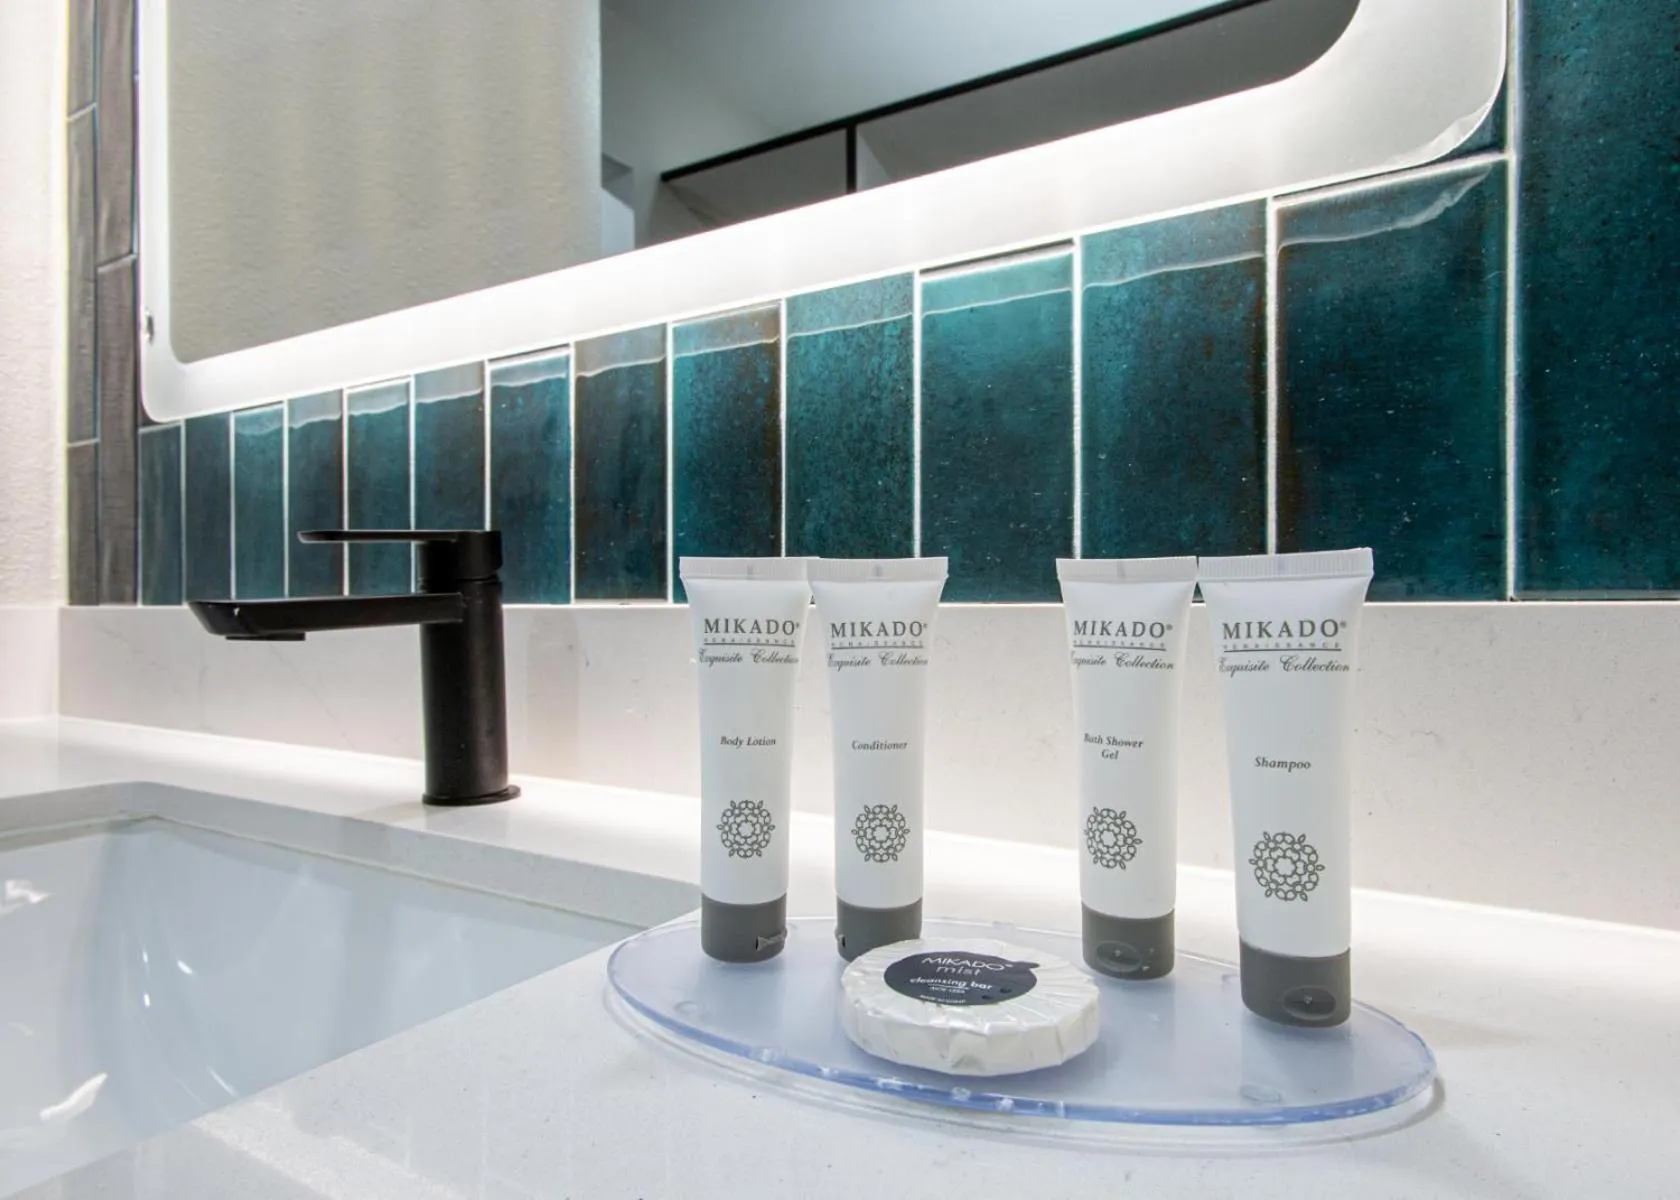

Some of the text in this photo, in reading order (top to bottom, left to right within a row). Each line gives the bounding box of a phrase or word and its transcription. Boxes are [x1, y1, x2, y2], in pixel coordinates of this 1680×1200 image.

[704, 618, 796, 636] MIKADO
[830, 620, 924, 638] MIKADO
[1073, 620, 1166, 639] MIKADO
[1222, 618, 1339, 639] MIKADO
[1113, 651, 1174, 670] Collection
[1279, 655, 1350, 673] Collection
[720, 735, 777, 748] Body Lotion
[851, 740, 908, 751] Conditioner
[1084, 733, 1144, 748] Bath Shower
[1101, 748, 1119, 760] Gel
[1254, 756, 1311, 772] Shampoo
[936, 966, 980, 976] mist
[909, 977, 968, 987] cleansing
[970, 980, 993, 990] bar
